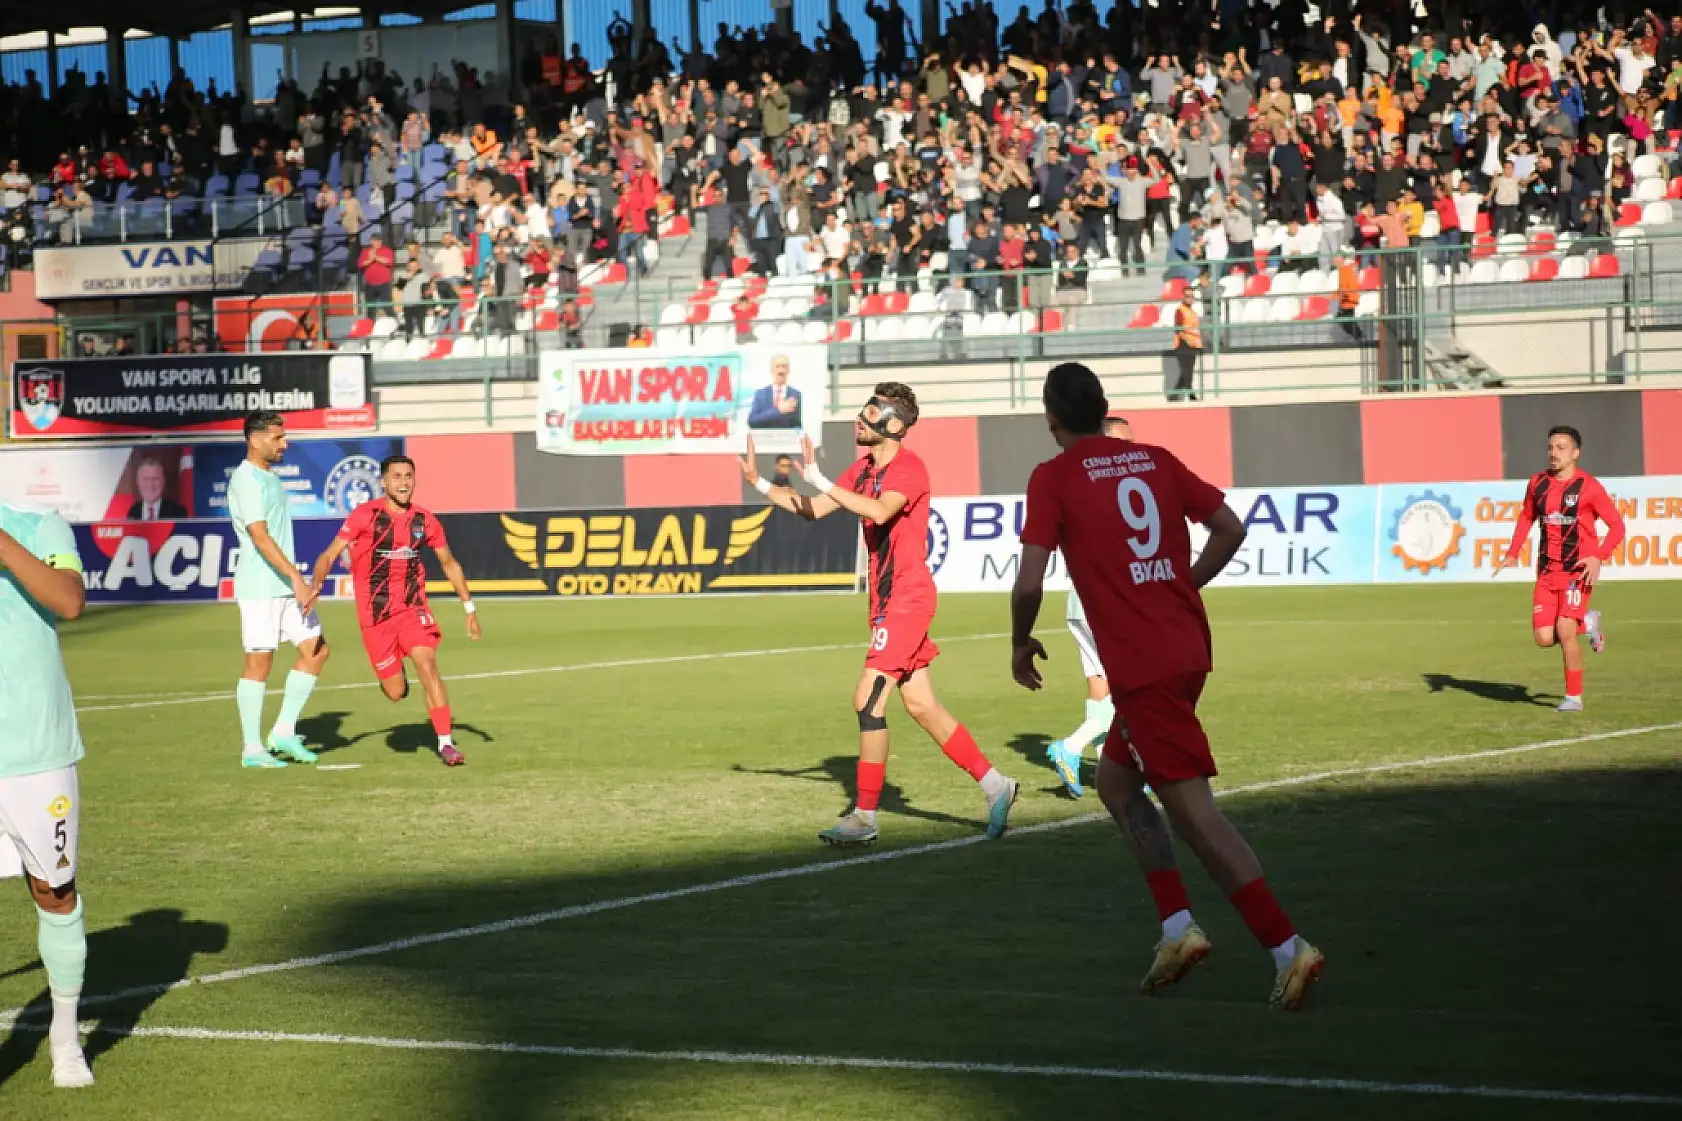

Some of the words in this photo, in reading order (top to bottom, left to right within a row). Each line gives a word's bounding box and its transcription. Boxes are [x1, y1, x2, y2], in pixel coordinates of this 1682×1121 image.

[120, 245, 213, 268] VAN
[145, 274, 172, 288] SPOR
[121, 370, 156, 388] VAN
[159, 367, 216, 387] SPOR'A
[220, 363, 261, 385] 1.LİG
[578, 368, 633, 405] VAN
[73, 396, 150, 416] YOLUNDA
[154, 393, 244, 416] BAŞARILAR
[247, 388, 315, 411] DİLERİM
[1116, 476, 1161, 559] 9
[544, 512, 720, 568] DELAL
[104, 534, 224, 591] AÇI
[557, 574, 609, 595] OTO
[1565, 589, 1582, 606] 10
[54, 818, 67, 852] 5
